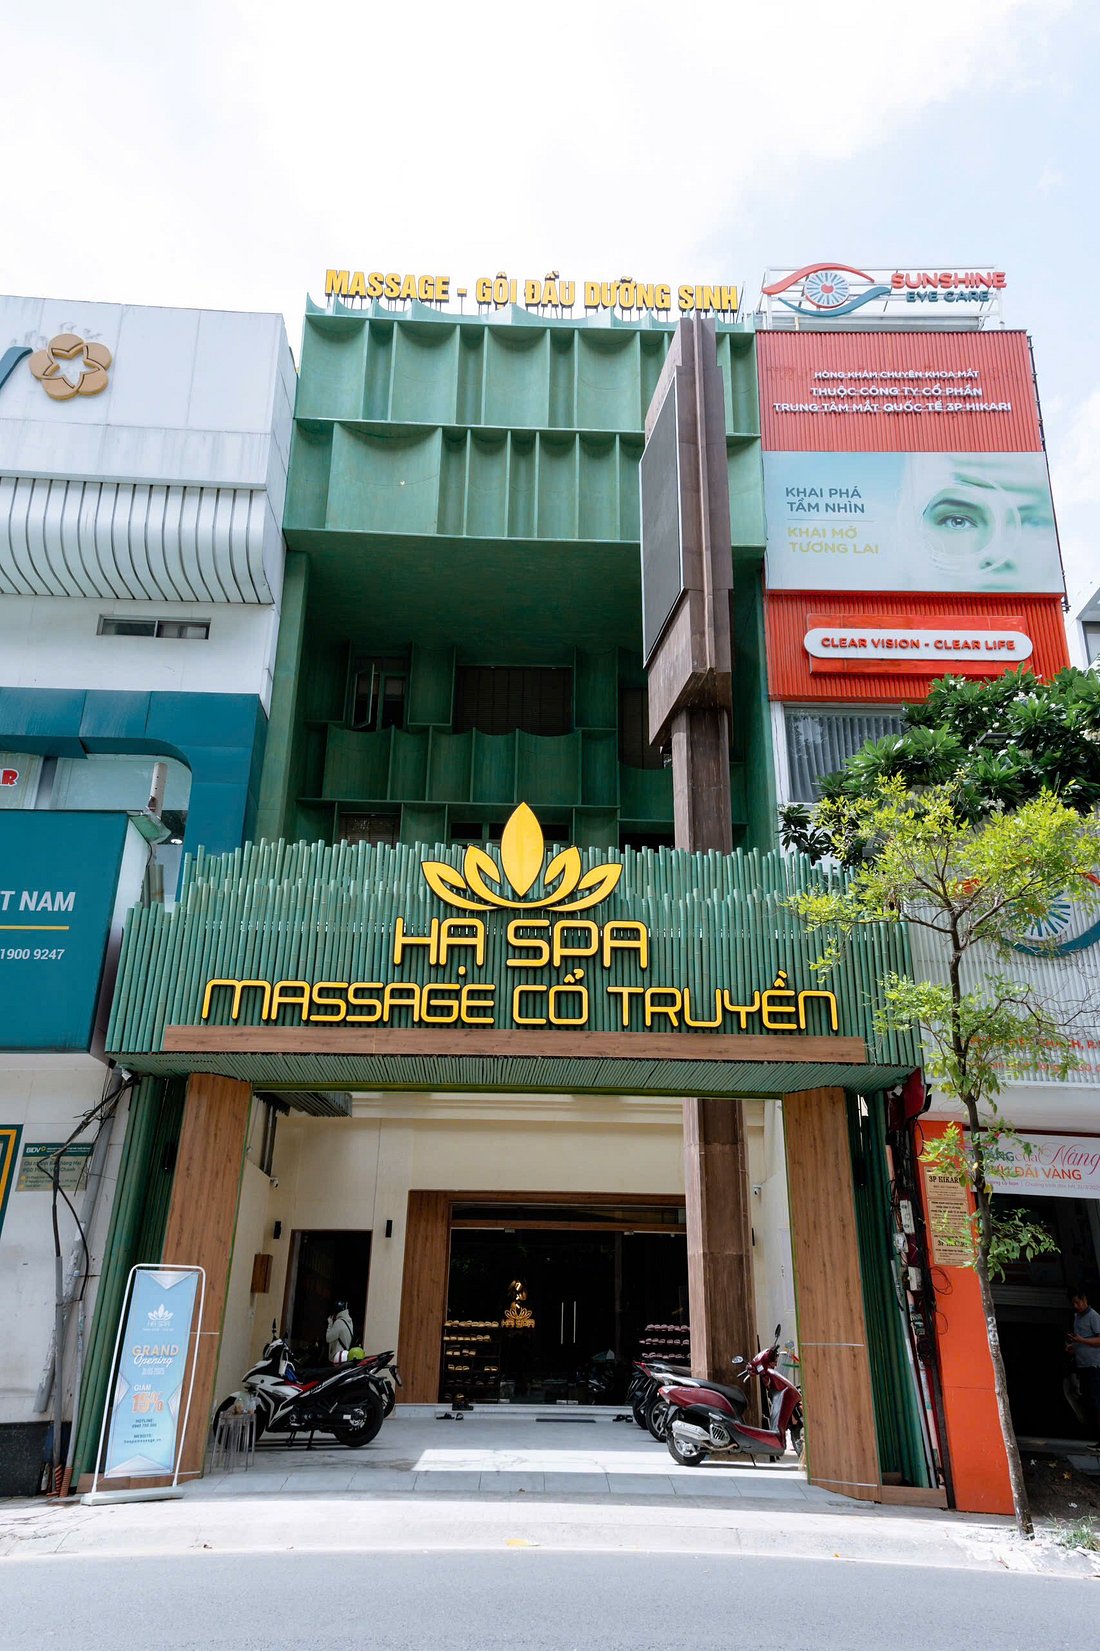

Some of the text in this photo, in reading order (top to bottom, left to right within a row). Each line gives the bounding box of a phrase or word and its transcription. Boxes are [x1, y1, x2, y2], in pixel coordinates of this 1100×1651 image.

[891, 272, 1007, 289] SUNSHINE
[325, 269, 450, 303] MASSAGE
[524, 271, 576, 308] ĐẦU
[584, 276, 671, 312] DƯỠNG
[678, 285, 739, 313] SINH
[906, 290, 990, 302] EYE CARE
[848, 371, 878, 380] KHÁM
[880, 370, 922, 379] CHUYÊN
[925, 371, 955, 379] KHOA
[811, 385, 856, 398] THUỘC
[860, 385, 899, 397] CÔNG
[902, 387, 918, 397] TY
[774, 402, 819, 413] TRUNG
[821, 401, 849, 413] TÂM
[883, 400, 922, 412] QUỐC
[926, 400, 943, 412] TẾ
[946, 403, 963, 412] 3P
[966, 402, 1012, 412] HIKARI
[785, 485, 862, 499] KHAI PHÁ
[786, 497, 865, 514] TẦM NHÌN
[786, 527, 827, 538] KHAI
[788, 541, 879, 554] TƯƠNG LAI
[821, 637, 868, 649] CLEAR
[871, 638, 920, 649] VISION
[933, 639, 981, 651] CLEAR
[985, 640, 1016, 651] LIFE
[19, 890, 76, 912] NAM
[506, 918, 648, 970] SPA
[0, 948, 65, 960] 1900 9247
[201, 967, 839, 1032] MASSAGE CỔ TRUYỀN
[1041, 1164, 1082, 1181] VÀNG
[132, 1344, 179, 1357] GRAND
[134, 1353, 173, 1368] Opening
